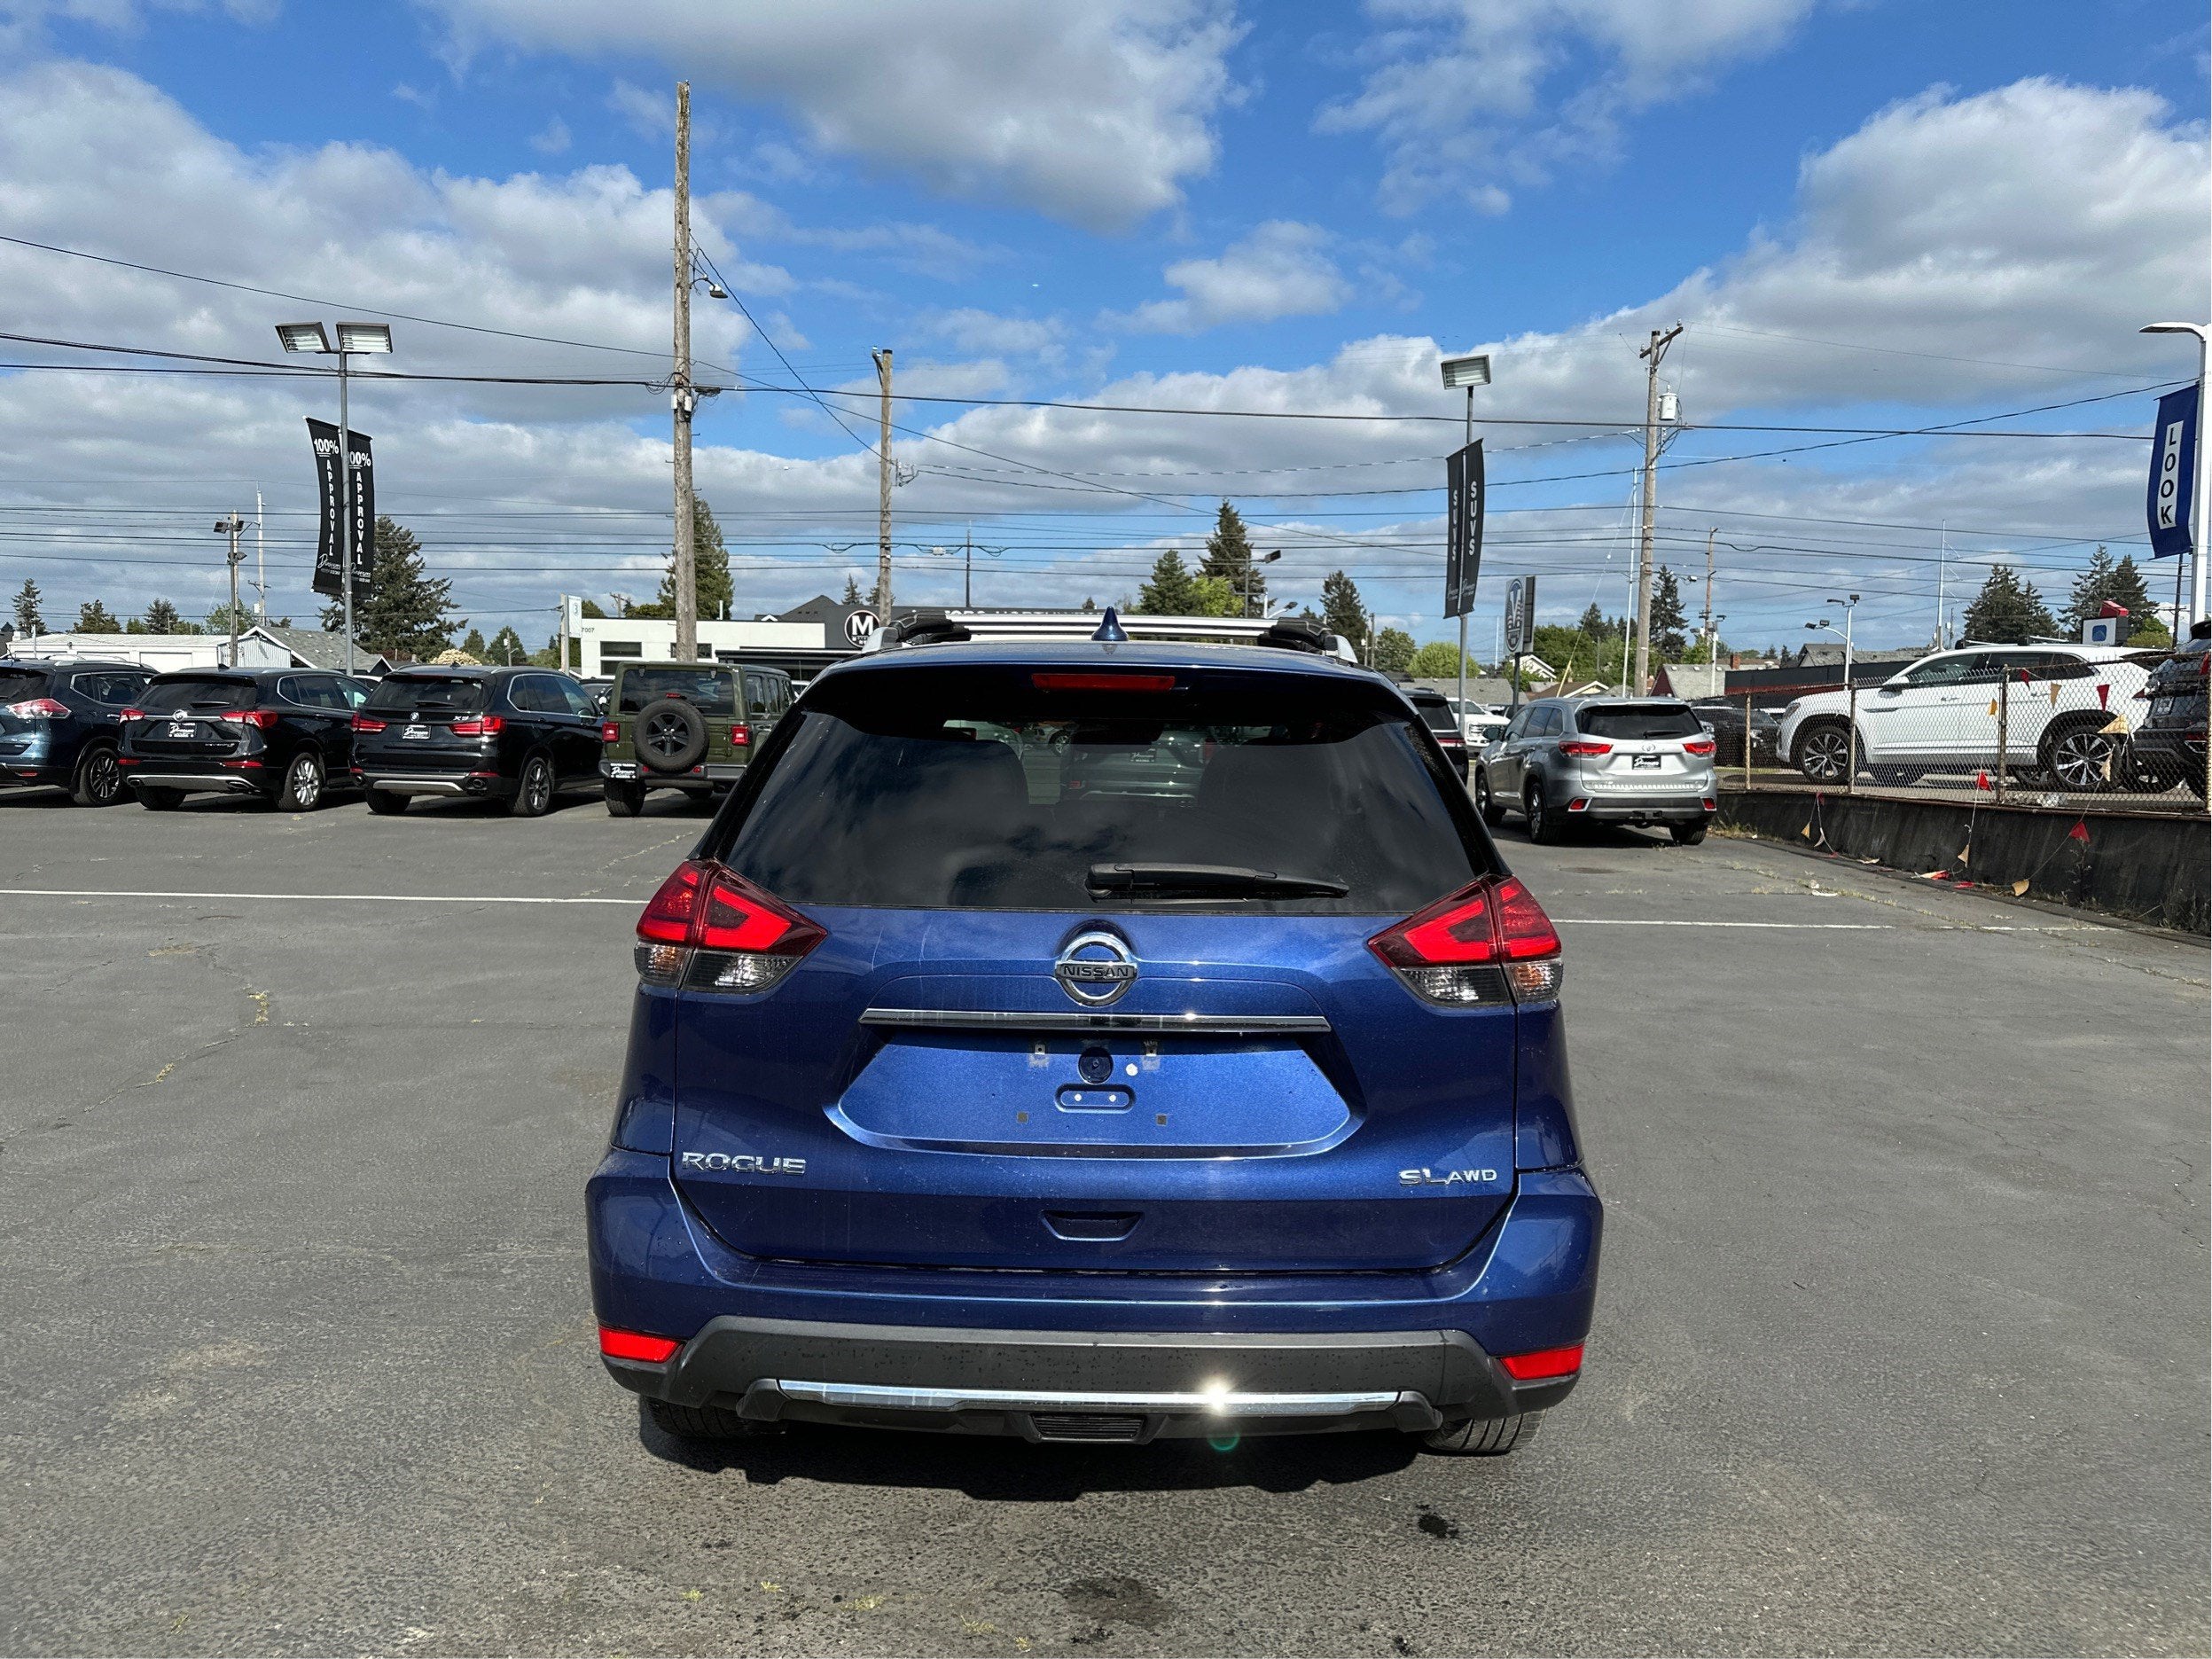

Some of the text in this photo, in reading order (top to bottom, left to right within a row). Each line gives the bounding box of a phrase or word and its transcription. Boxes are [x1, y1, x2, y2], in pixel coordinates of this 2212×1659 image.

[314, 438, 340, 455] 100%
[348, 450, 371, 467] 00%
[2160, 426, 2177, 525] LOOK
[325, 459, 335, 557] APPROVAL
[356, 471, 364, 566] APPROVAL
[1468, 480, 1478, 556] SUVS
[852, 615, 874, 636] M
[1064, 966, 1129, 977] NISSAN
[682, 1152, 806, 1176] ROGUE
[1399, 1169, 1497, 1186] SL AWD
